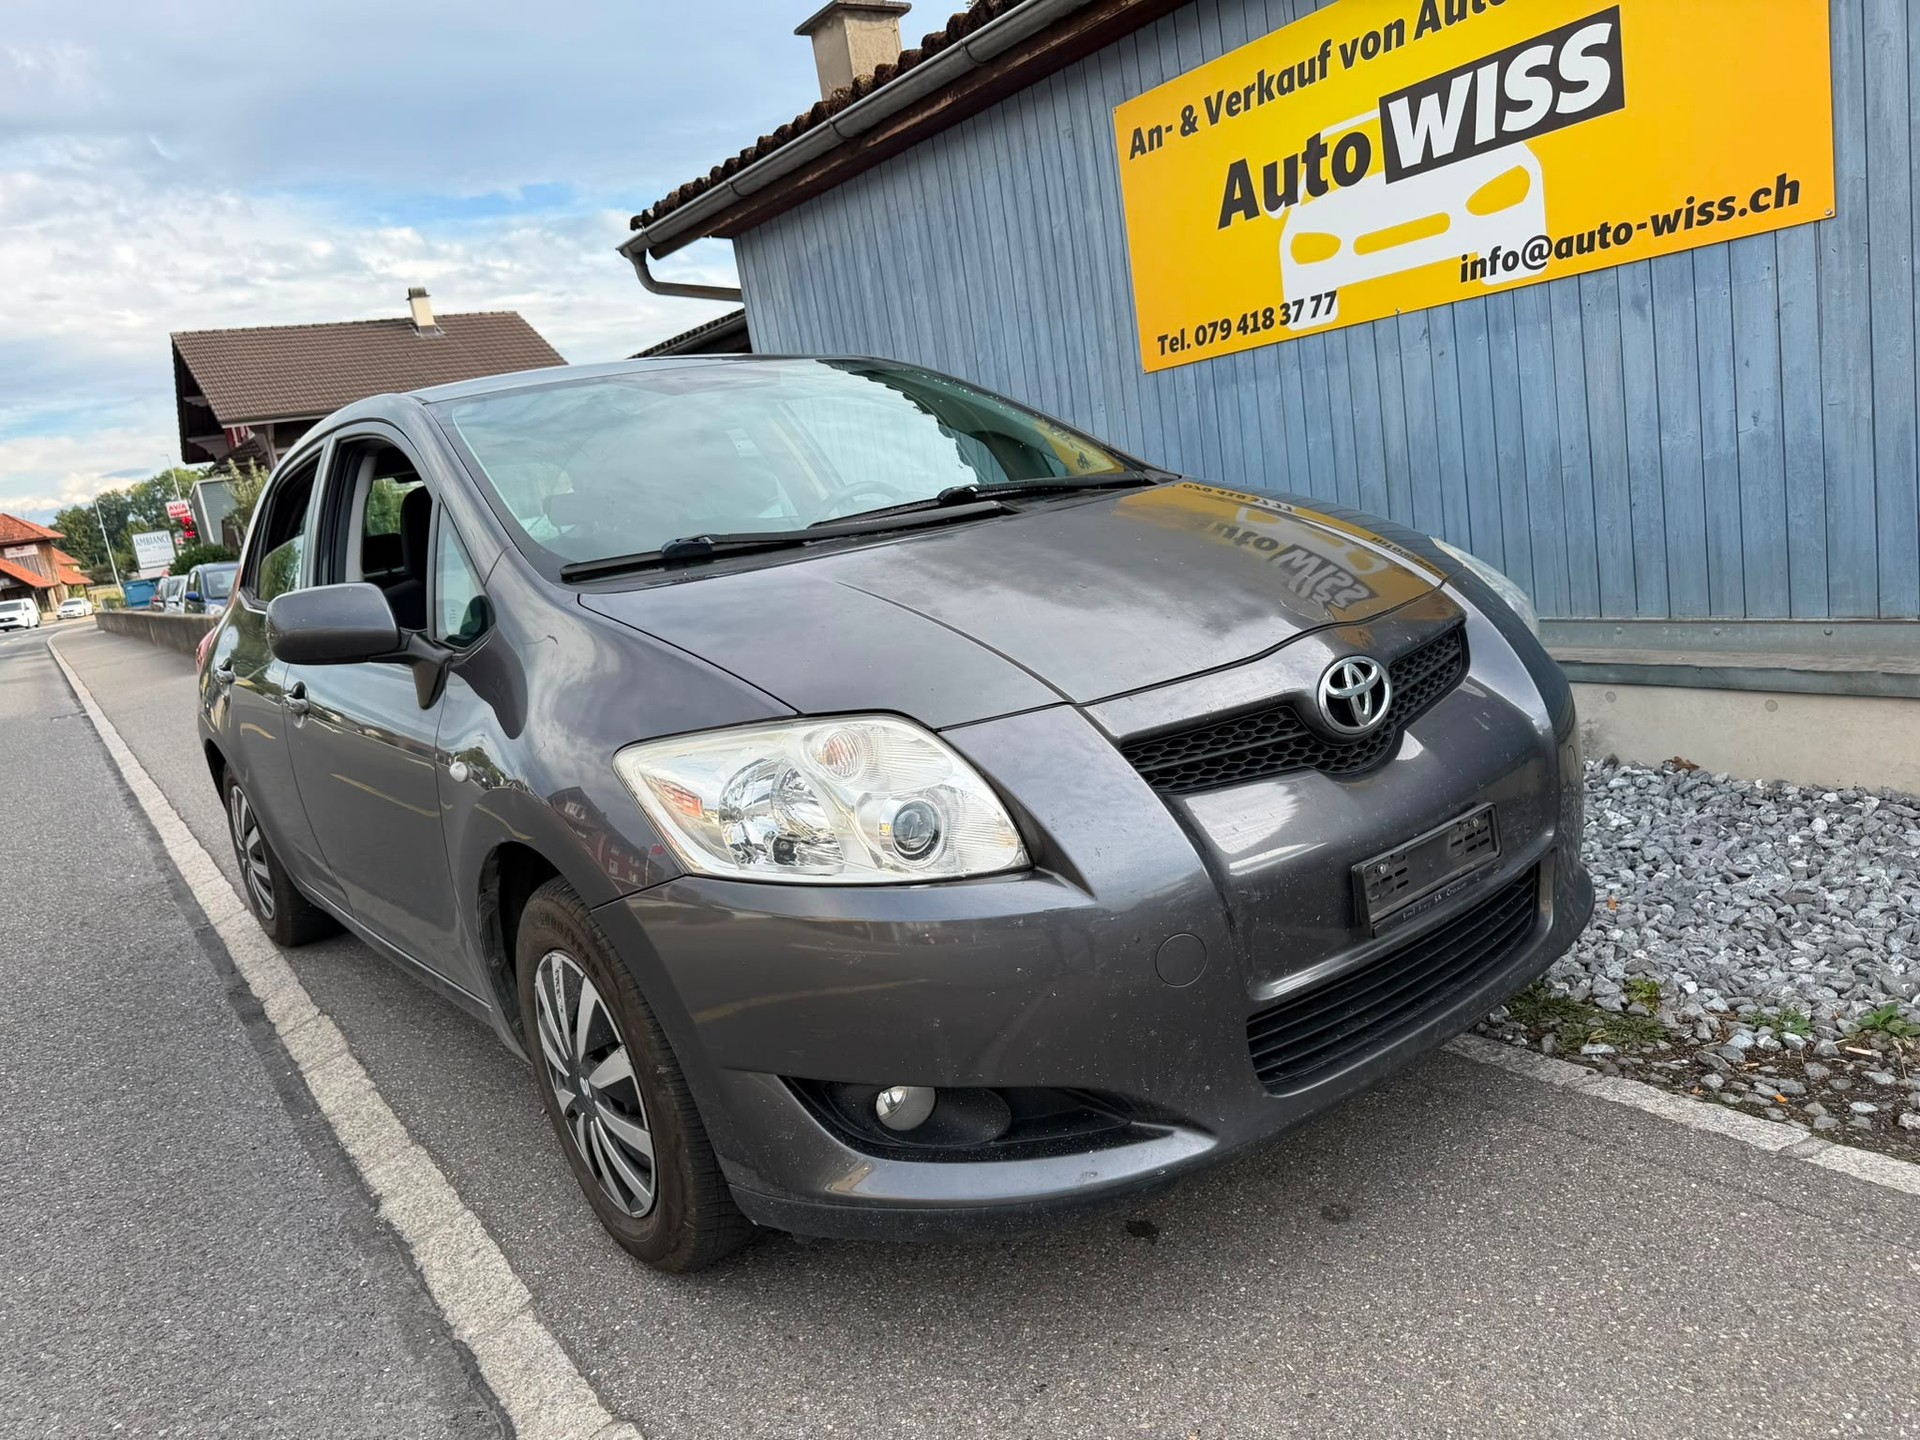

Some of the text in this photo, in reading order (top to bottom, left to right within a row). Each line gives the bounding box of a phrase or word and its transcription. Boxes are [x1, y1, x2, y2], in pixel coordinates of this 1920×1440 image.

[1129, 124, 1173, 160] An-
[1180, 105, 1199, 137] &
[1204, 39, 1332, 126] Verkauf
[1339, 18, 1405, 70] von
[1218, 23, 1613, 230] Auto WISS
[1460, 173, 1801, 283] info@auto-wiss.ch
[1157, 290, 1337, 356] Tel. 079 418 37 77
[135, 534, 171, 546] AMBIANCE
[168, 503, 187, 511] AVIA
